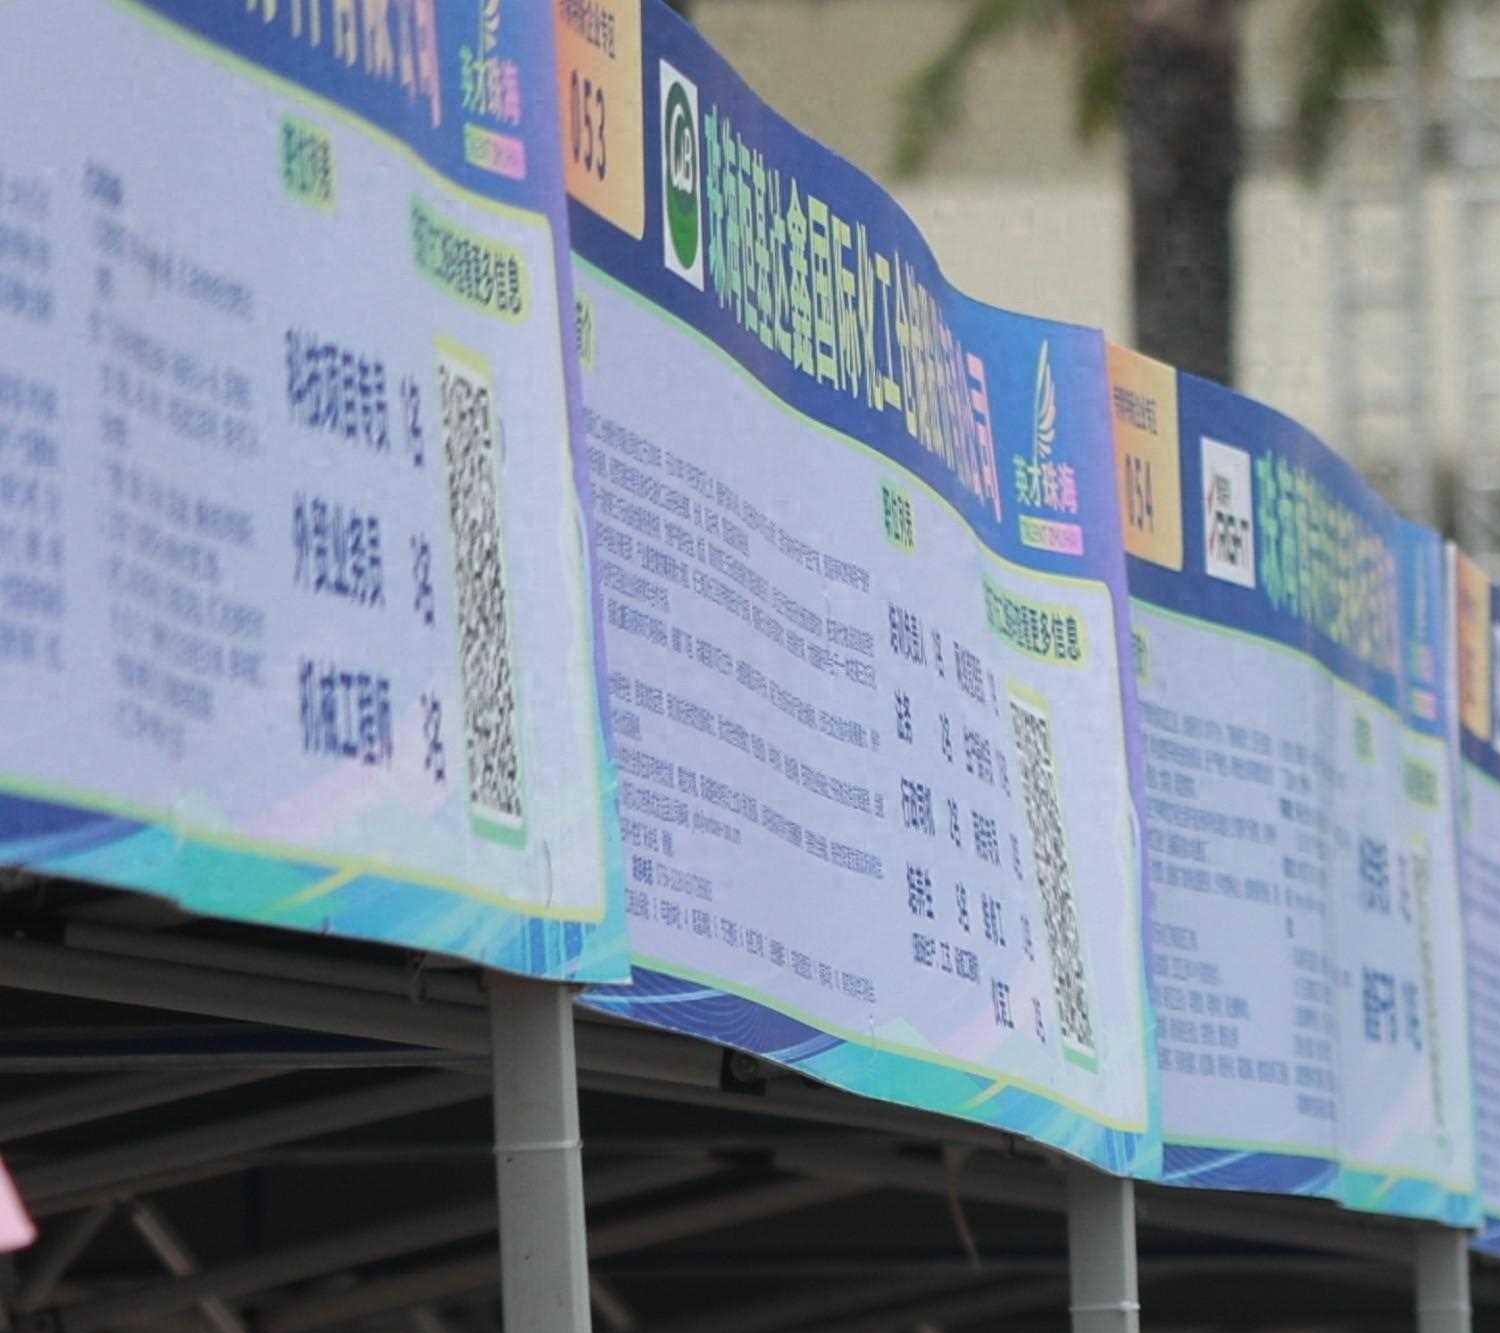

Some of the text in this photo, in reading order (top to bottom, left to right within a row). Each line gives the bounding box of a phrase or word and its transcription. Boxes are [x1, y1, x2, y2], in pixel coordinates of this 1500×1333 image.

[570, 70, 607, 181] 053
[1012, 452, 1078, 515] 英才珠海
[1124, 454, 1154, 533] 054
[293, 490, 387, 608] 外贸业务员
[299, 652, 395, 764] 机械工程师
